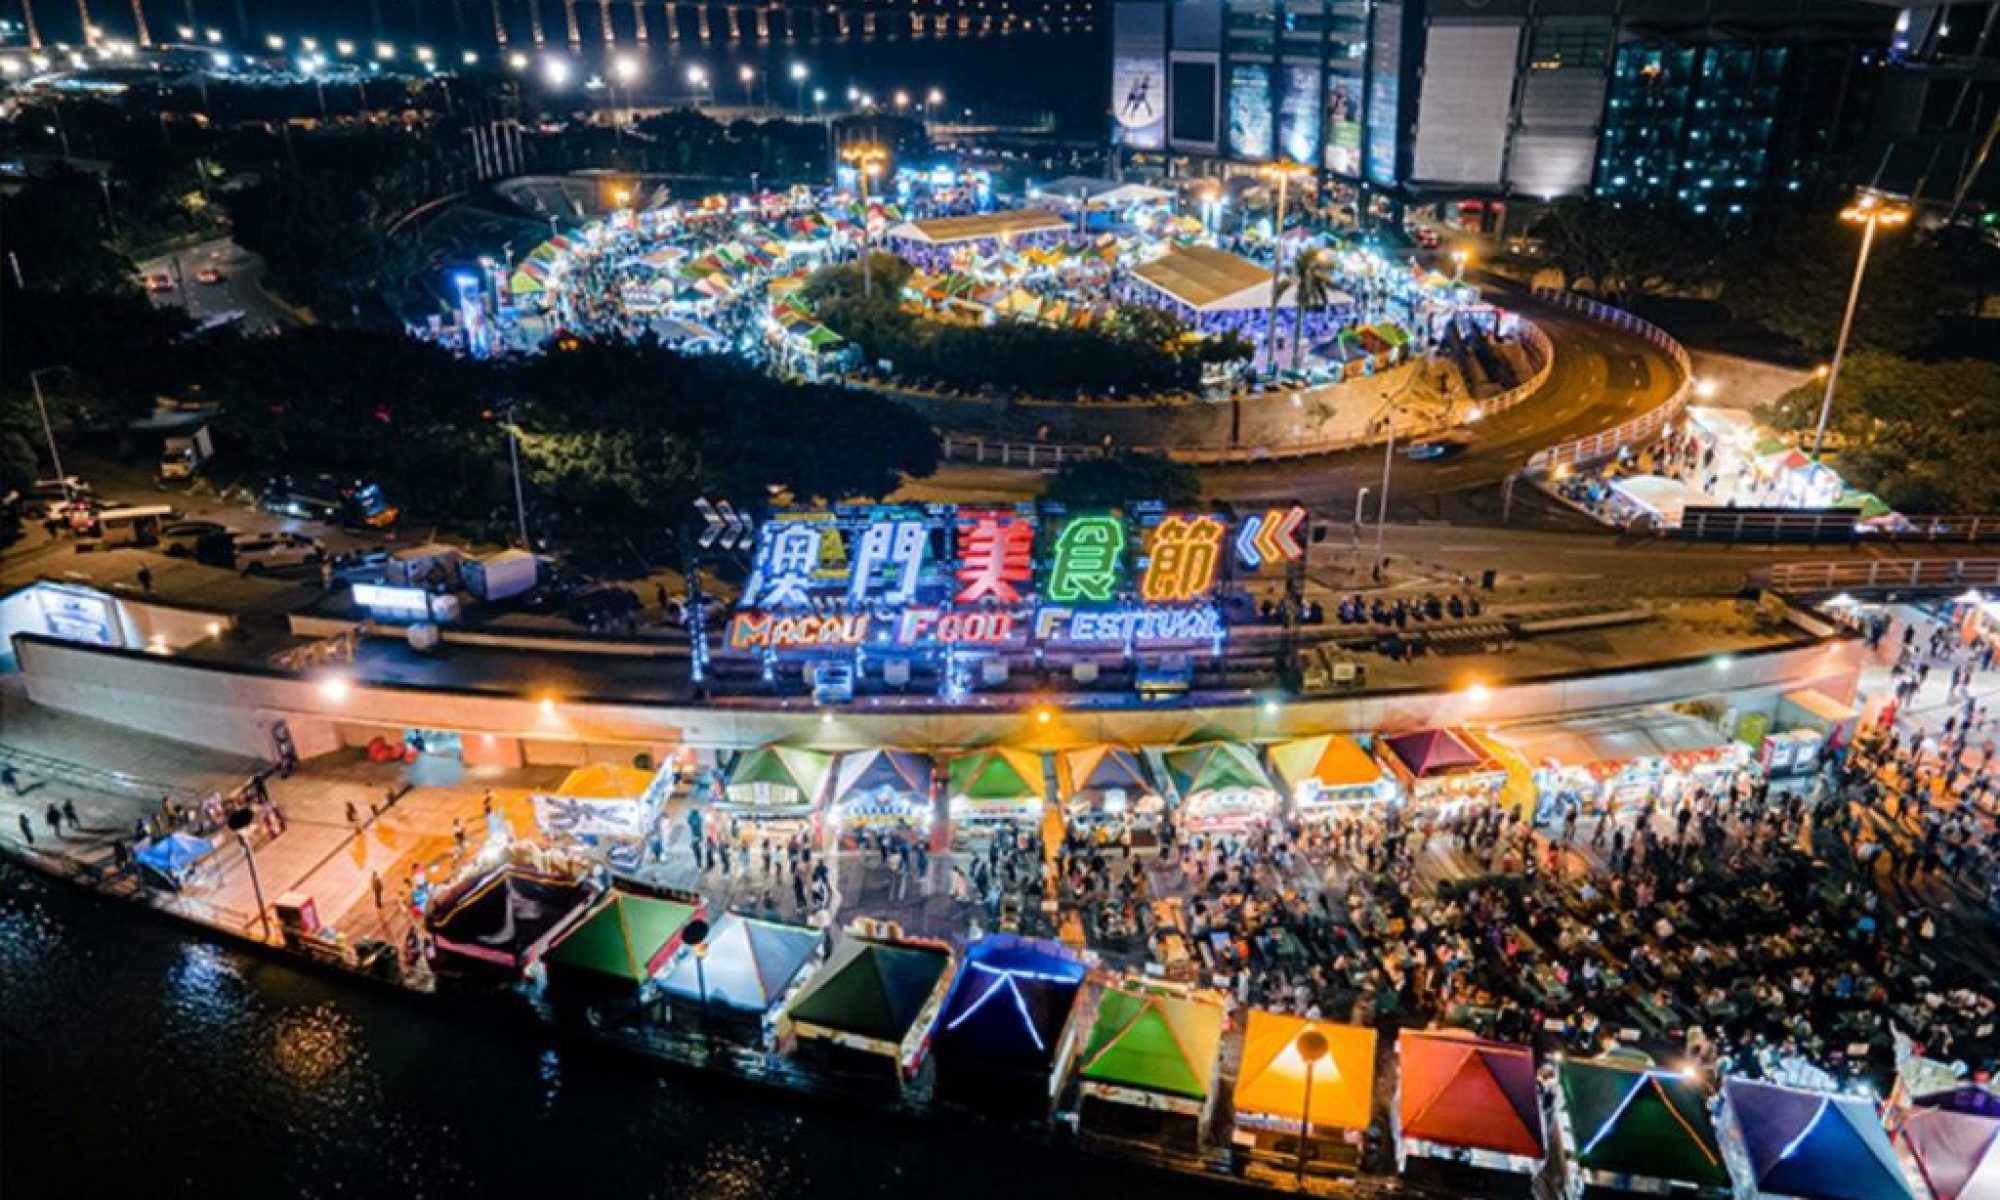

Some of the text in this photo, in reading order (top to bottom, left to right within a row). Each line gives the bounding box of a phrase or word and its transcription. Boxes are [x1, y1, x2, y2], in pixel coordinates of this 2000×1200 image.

[739, 514, 1226, 605] 澳門美食節
[730, 607, 1226, 648] MACAU FOOD FESTIVAL
